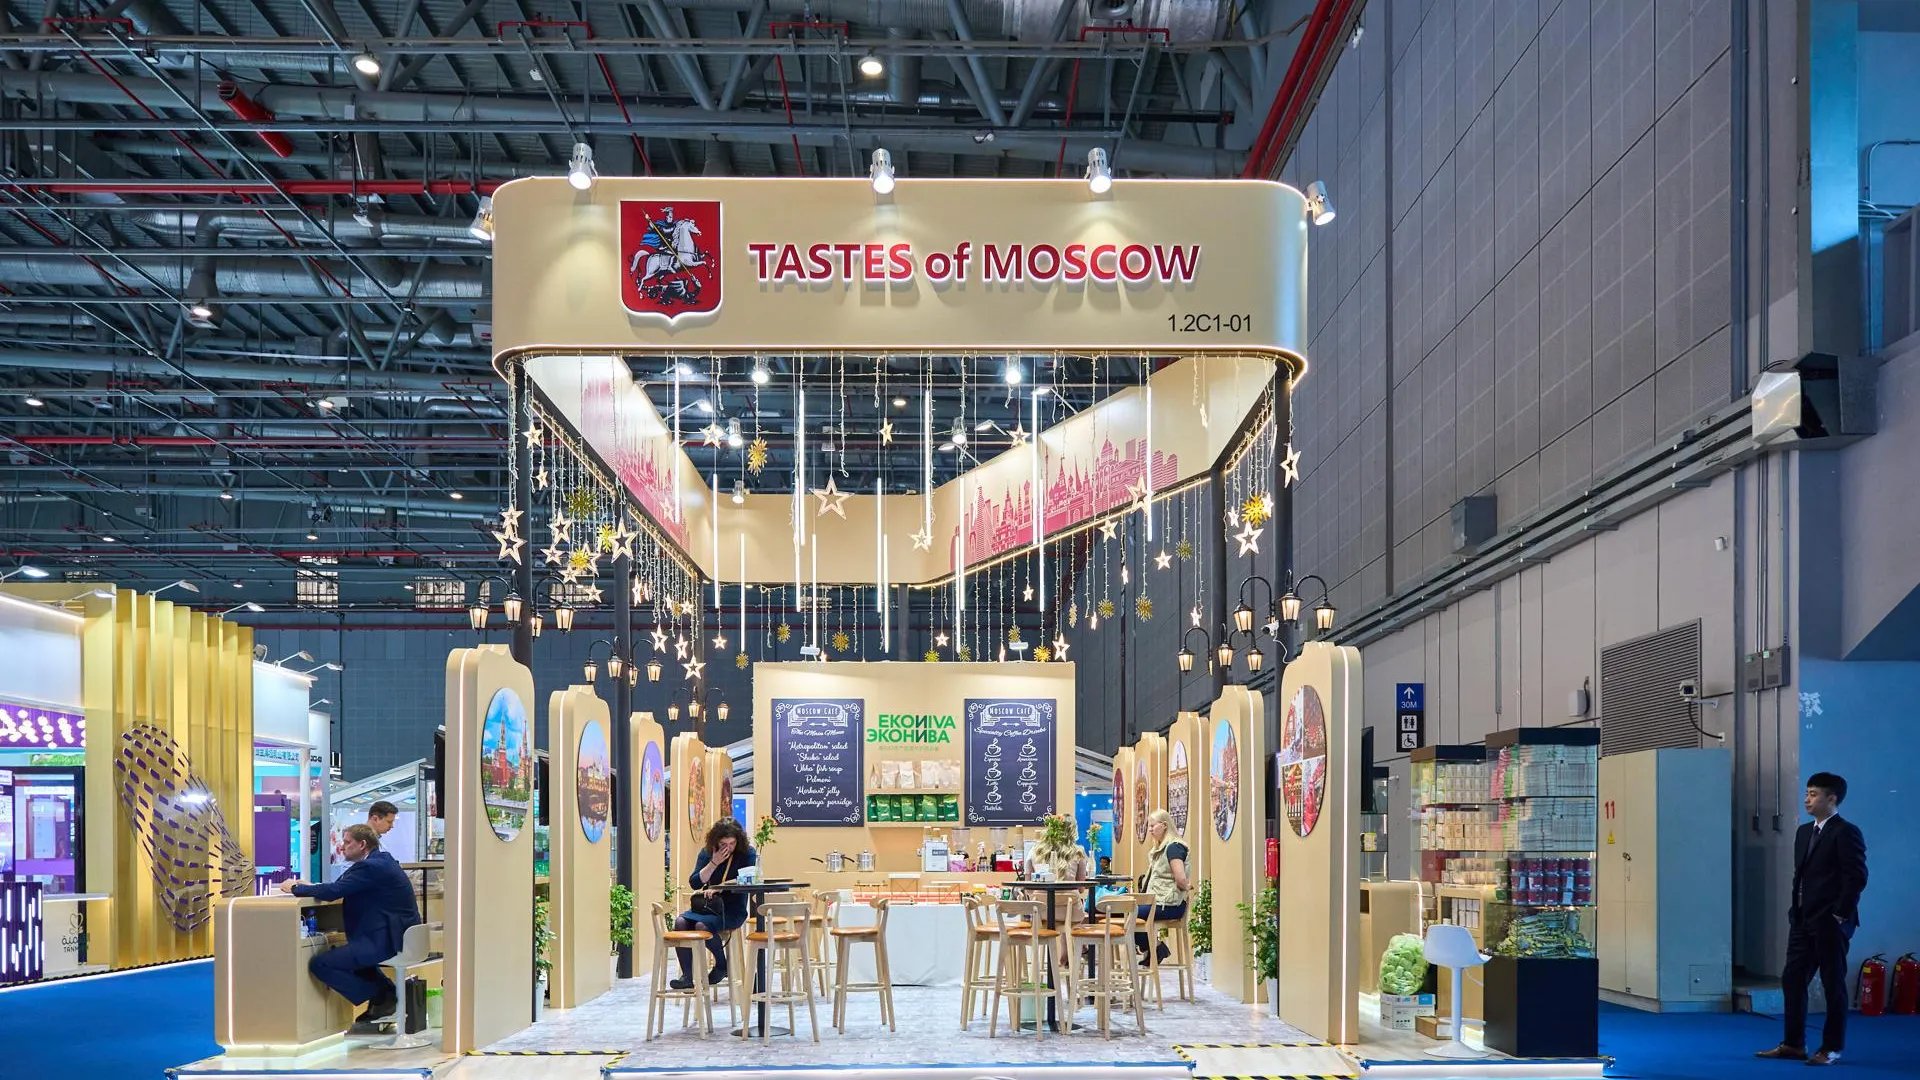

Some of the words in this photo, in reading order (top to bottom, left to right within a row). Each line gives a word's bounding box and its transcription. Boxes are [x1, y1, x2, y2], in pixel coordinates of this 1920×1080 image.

[749, 243, 912, 281] TASTES
[925, 241, 972, 281] of
[984, 243, 1201, 281] MOSCOW
[1168, 313, 1252, 333] 1.2C1-01
[796, 707, 821, 715] MOSCOW
[989, 707, 1014, 715] MOSCOW
[866, 728, 951, 743] ЭКОНИВА
[831, 741, 848, 750] salad
[823, 752, 840, 761] salad
[816, 763, 828, 774] fish
[828, 766, 844, 775] soup
[804, 774, 831, 783] Pelmeni
[825, 786, 841, 796] jelly
[826, 797, 853, 808] porridge
[1604, 801, 1615, 819] 11
